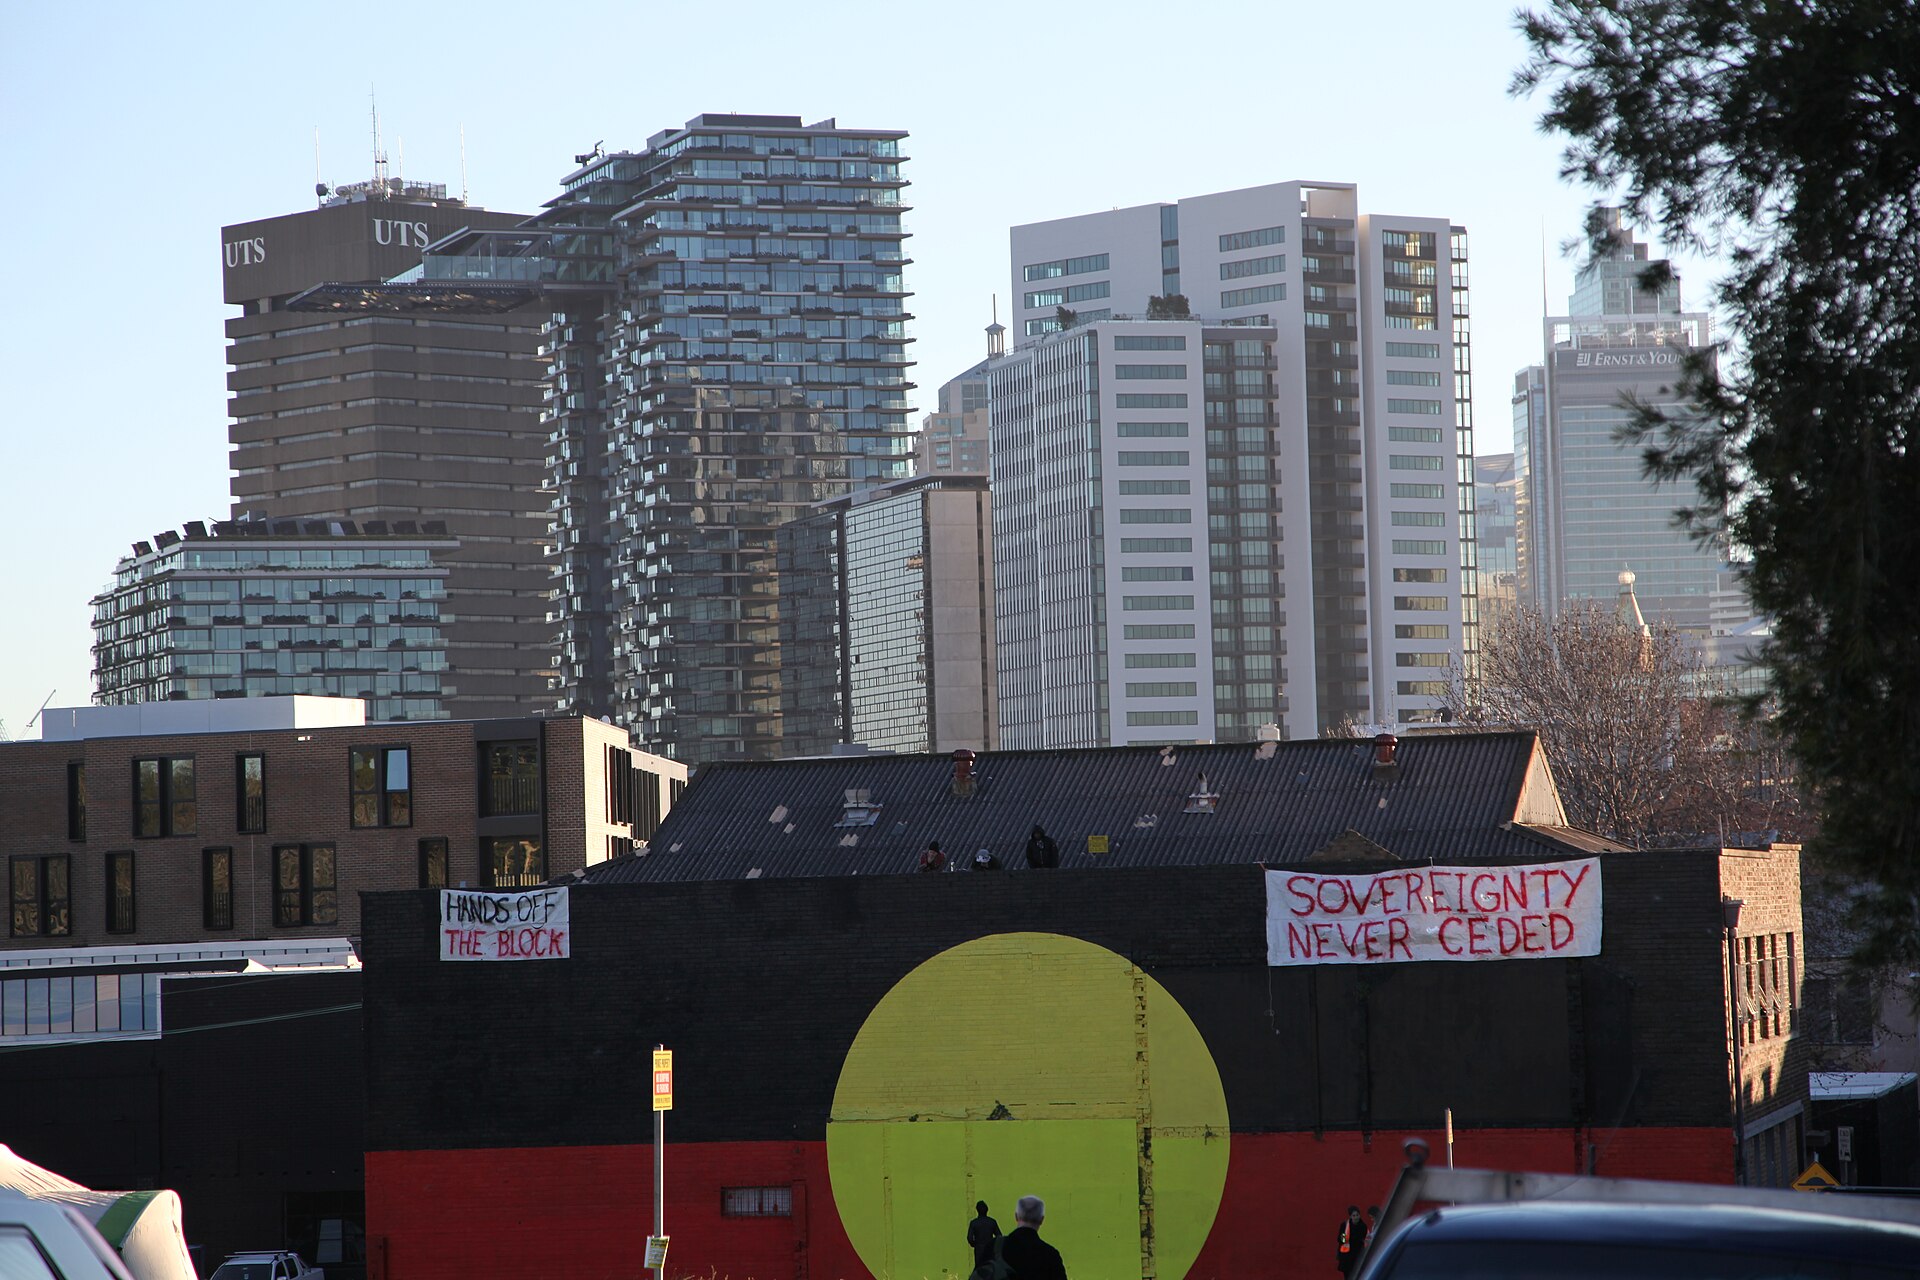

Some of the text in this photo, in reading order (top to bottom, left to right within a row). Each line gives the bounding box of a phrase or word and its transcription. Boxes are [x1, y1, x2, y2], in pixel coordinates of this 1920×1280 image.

[373, 218, 429, 248] UTS
[224, 236, 266, 268] UTS
[1595, 351, 1687, 366] ERNST & YOUN
[1286, 865, 1590, 916] SOVEREIGNTY
[446, 891, 558, 923] HANDS OFF
[444, 928, 565, 958] THE BLOCK
[1288, 913, 1574, 960] NEVER CEDED
